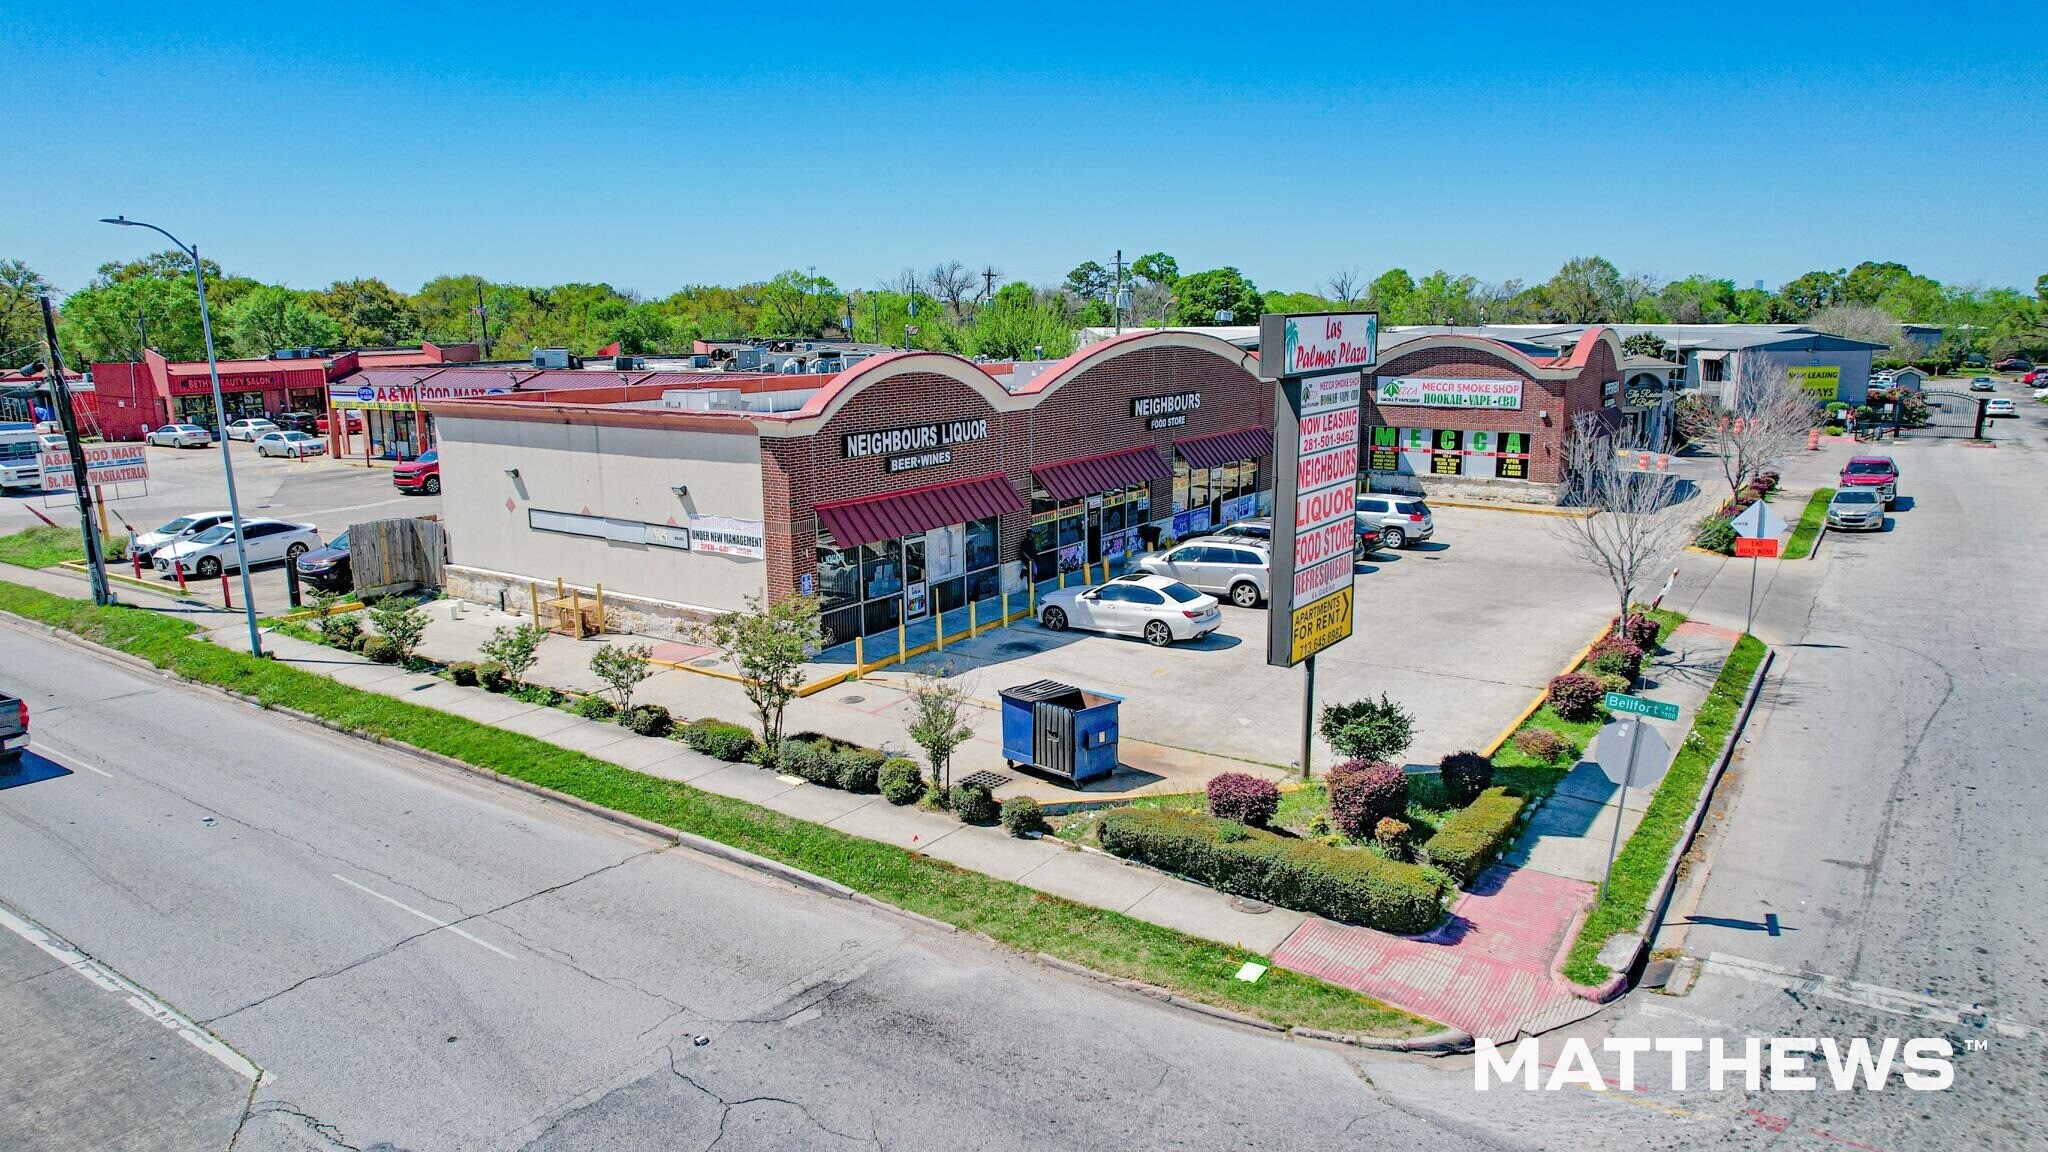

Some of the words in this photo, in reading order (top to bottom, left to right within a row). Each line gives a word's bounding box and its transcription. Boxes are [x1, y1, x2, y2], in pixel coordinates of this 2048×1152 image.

[1326, 317, 1342, 340] Las
[1295, 345, 1336, 369] Palmas
[1338, 341, 1367, 364] Plaza
[245, 376, 271, 386] SALON
[1808, 371, 1838, 379] LEASING
[376, 387, 414, 403] A&M
[420, 387, 450, 400] FOOD
[1422, 382, 1455, 392] MECCA
[1457, 383, 1491, 394] SMOKE
[1493, 384, 1520, 395] SHOP
[1423, 393, 1463, 405] HOOKAH
[1468, 395, 1493, 406] VAPE
[1497, 396, 1517, 407] CBD
[1135, 393, 1201, 416] NEIGHBOURS
[1151, 419, 1167, 429] FOOD
[1168, 416, 1186, 427] STORE
[1301, 416, 1320, 436] NOW
[1322, 409, 1357, 432] LEASING
[847, 430, 938, 457] NEIGHBOURS
[942, 419, 988, 444] LIQUOR
[1304, 430, 1354, 452] 281-501-9462
[111, 447, 143, 460] MART
[47, 477, 60, 488] St.
[89, 466, 147, 484] WASHATERIA
[1298, 448, 1357, 489] NEIGHBOURS
[1296, 486, 1354, 527] LIQUOR
[691, 529, 711, 541] UNDER
[710, 531, 724, 543] NEW
[723, 533, 763, 549] MANAGEMENT
[1295, 531, 1321, 566] FOOD
[1323, 520, 1354, 557] STORE
[1295, 554, 1351, 597] REFRESQUERIA
[1295, 595, 1341, 627] APARTMENTS
[1293, 622, 1313, 645] FOR
[1316, 609, 1341, 632] RENT
[1299, 625, 1343, 658] 713.645.8982
[1608, 696, 1660, 715] Bellfort
[1665, 705, 1676, 713] AVE
